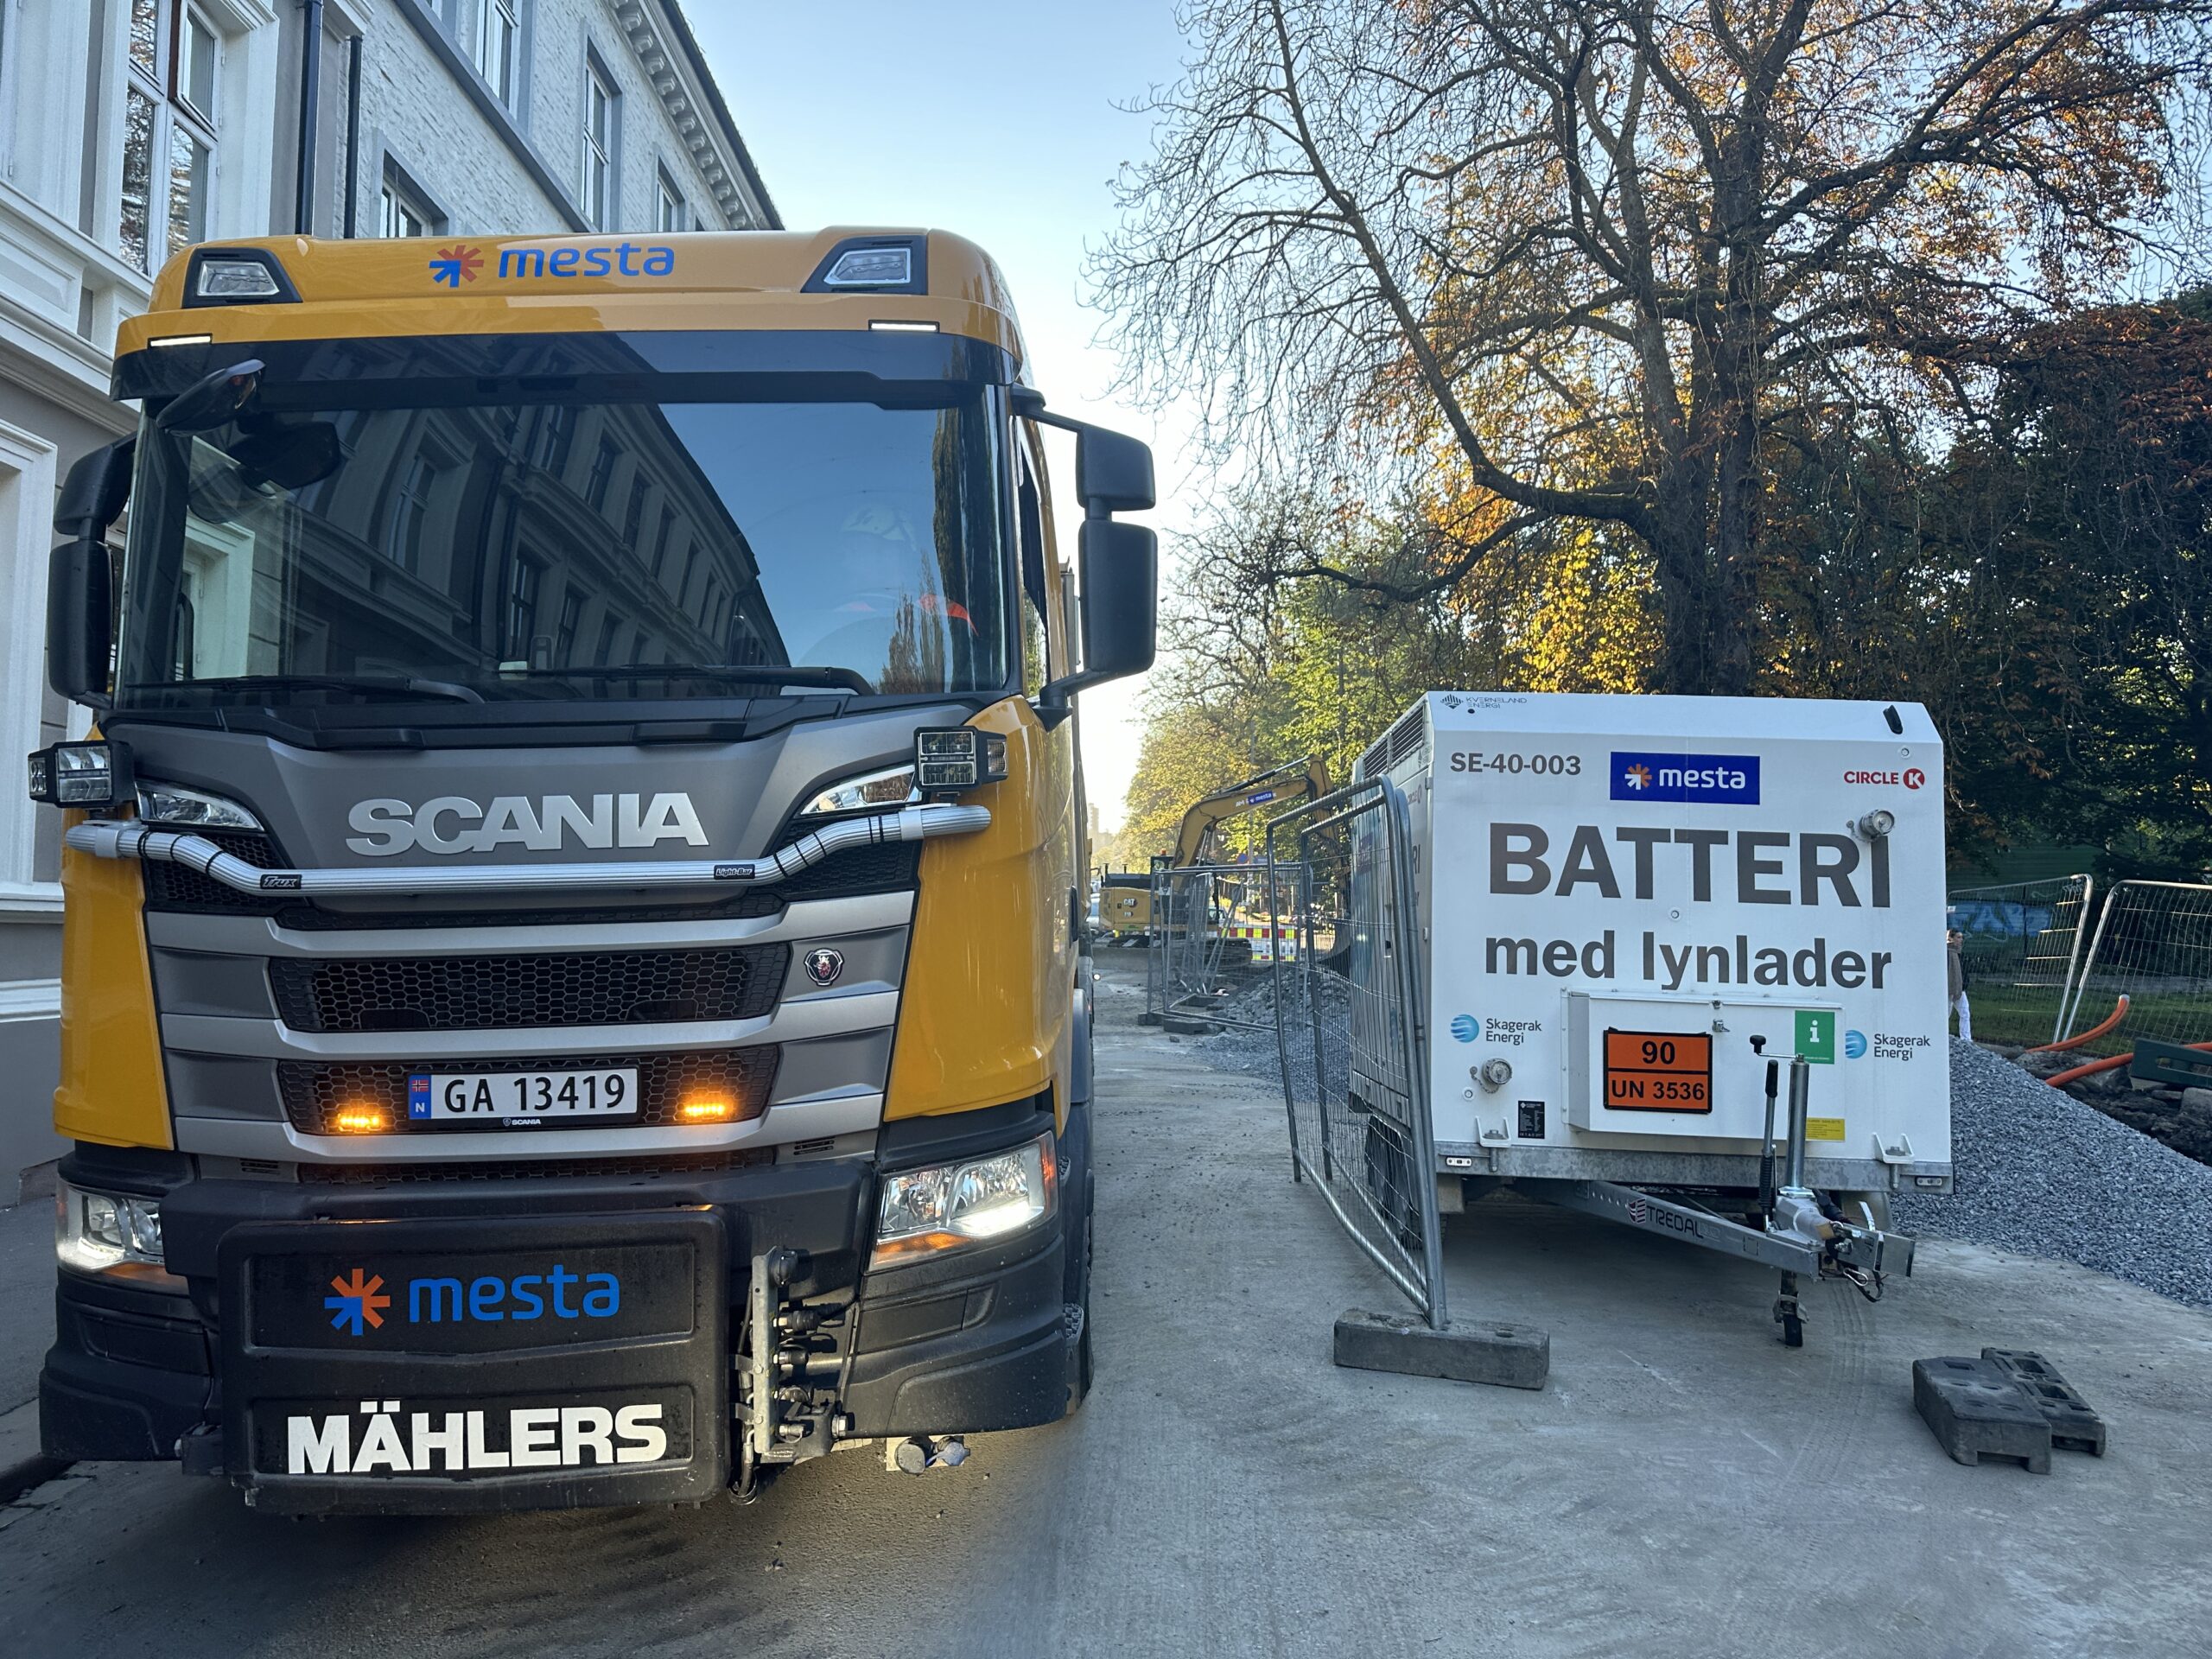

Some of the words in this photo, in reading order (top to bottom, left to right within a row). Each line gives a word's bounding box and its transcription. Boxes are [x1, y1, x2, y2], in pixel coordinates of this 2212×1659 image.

[499, 243, 675, 278] mesta
[1450, 752, 1581, 775] SE-40-003
[1659, 766, 1746, 790] mesta
[1843, 771, 1899, 785] CIRCLE
[1903, 768, 1925, 790] K
[1255, 792, 1272, 801] mesta
[346, 791, 709, 856] SCANIA
[1490, 822, 1891, 907] BATTERI
[263, 875, 297, 887] Trux
[1485, 930, 1615, 978] med
[1643, 931, 1891, 990] lynlader
[1485, 1017, 1542, 1033] Skagerak
[1485, 1029, 1524, 1044] Energi
[1874, 1033, 1930, 1048] Skagerak
[1642, 1041, 1675, 1065] 90
[1874, 1046, 1913, 1061] Energi
[444, 1078, 494, 1113] GA
[513, 1074, 625, 1111] 13419
[1611, 1079, 1644, 1099] UN
[1653, 1080, 1705, 1101] 3536
[1646, 1205, 1704, 1238] TREDAL
[409, 1263, 620, 1323] mesta
[287, 1400, 665, 1474] MÄHLERS
